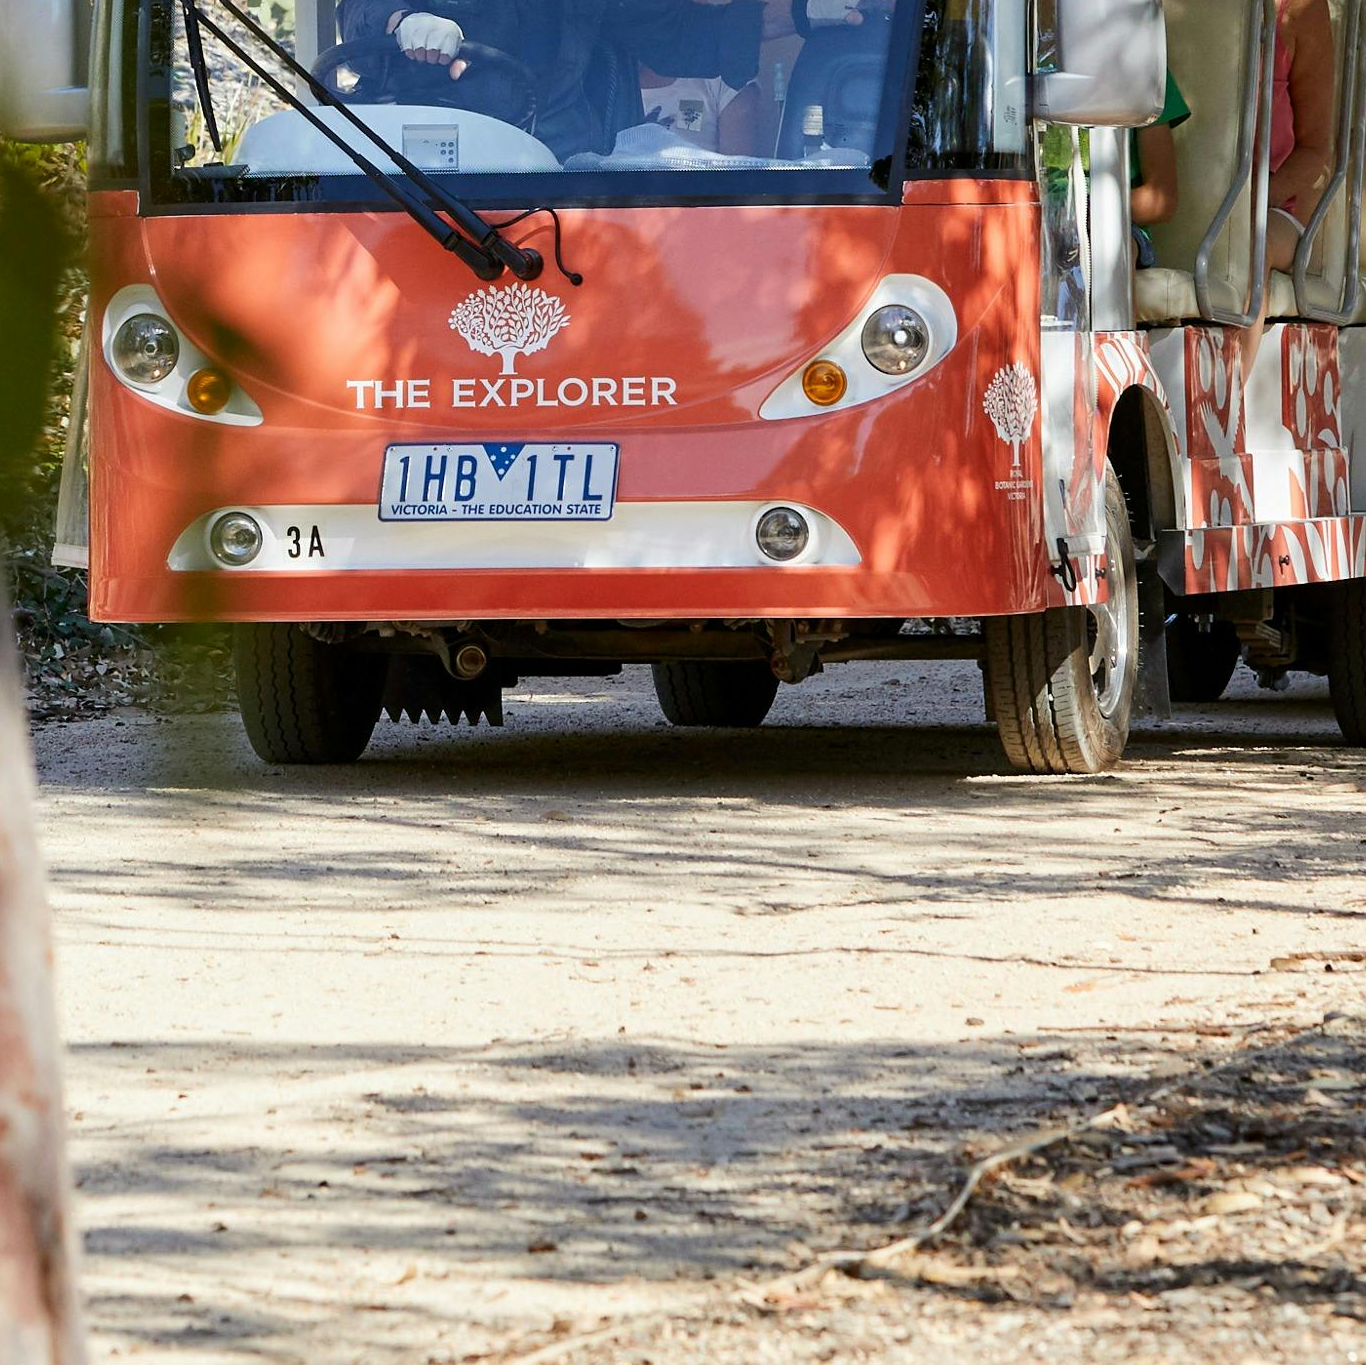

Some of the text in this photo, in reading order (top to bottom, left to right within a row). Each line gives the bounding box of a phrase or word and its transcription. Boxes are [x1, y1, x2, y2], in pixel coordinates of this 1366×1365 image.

[346, 376, 678, 409] THE EXPLORER
[399, 454, 603, 502] 1HB 1TL
[391, 503, 448, 516] VICTORIA
[461, 503, 485, 515] THE
[488, 503, 563, 515] EDUCATION
[566, 503, 602, 515] STATE
[287, 524, 325, 558] 3A
